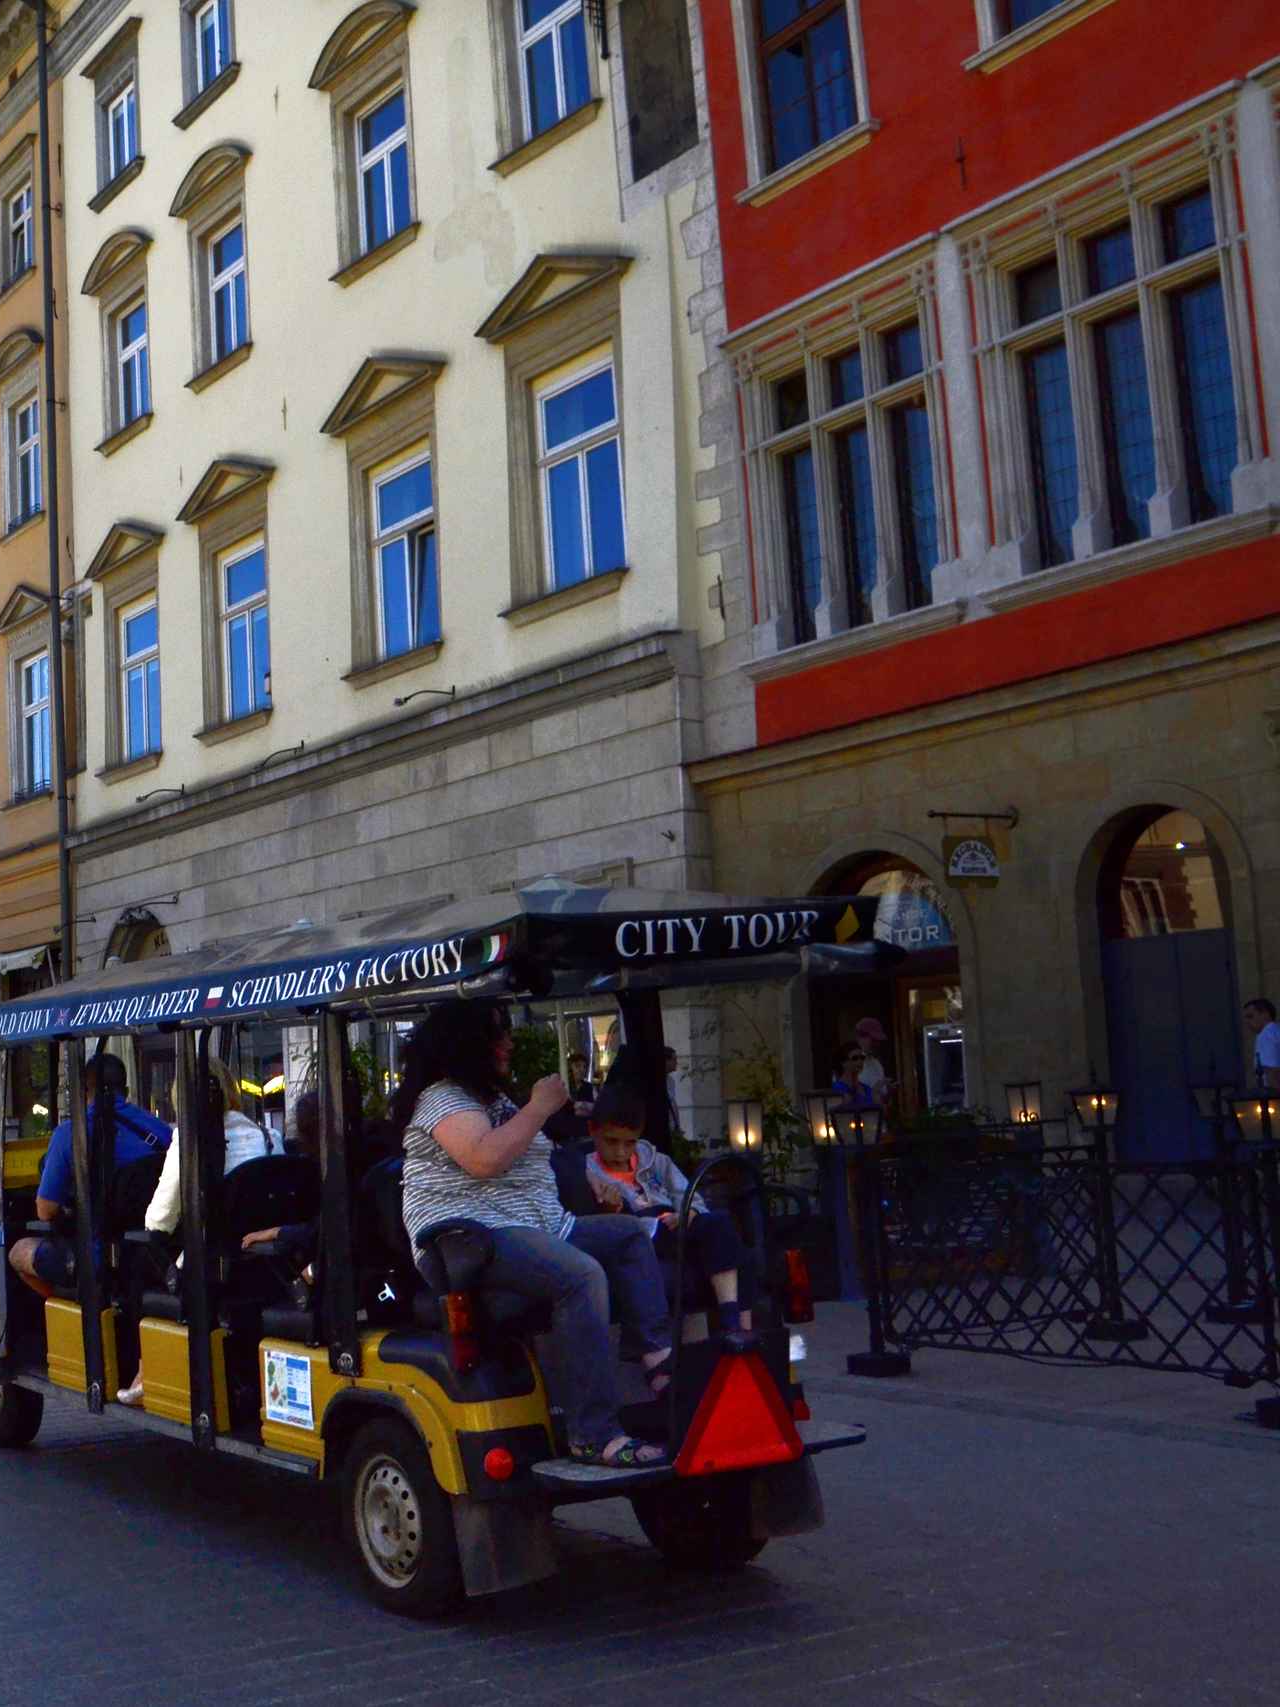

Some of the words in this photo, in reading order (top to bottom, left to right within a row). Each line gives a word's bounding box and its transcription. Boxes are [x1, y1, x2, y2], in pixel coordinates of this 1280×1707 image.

[614, 917, 707, 959] CITY
[723, 911, 819, 950] TOUR
[16, 1008, 55, 1036] TOWN
[69, 997, 128, 1027] JEWISH
[124, 987, 200, 1025] QUARTER
[226, 960, 351, 1009] SCHINDLER'S
[353, 937, 465, 990] FACTORY
